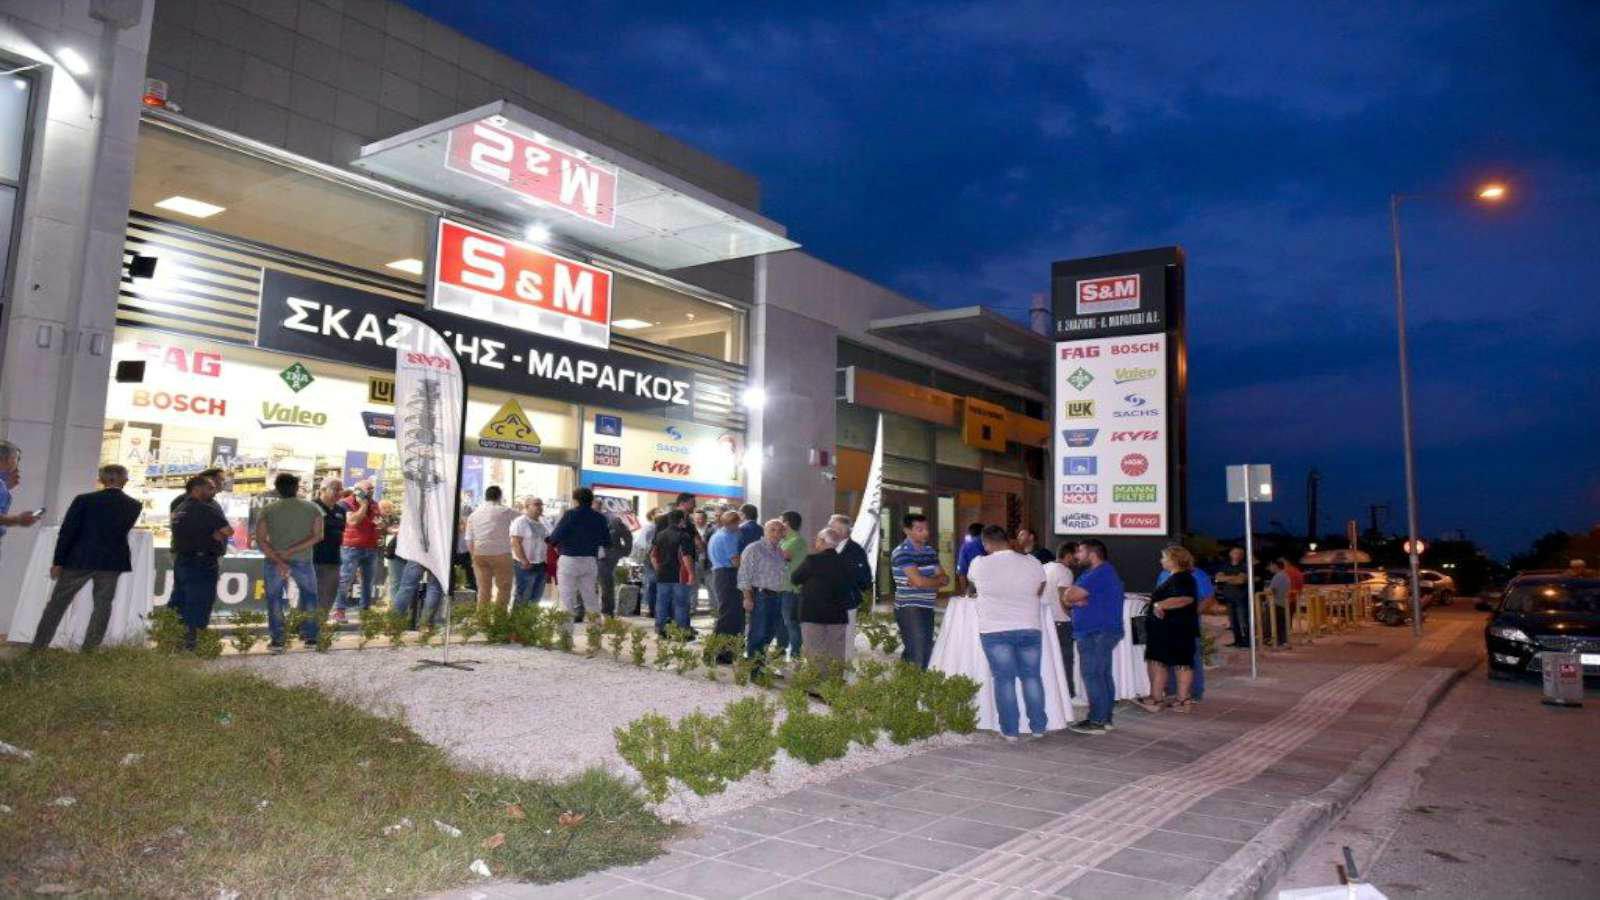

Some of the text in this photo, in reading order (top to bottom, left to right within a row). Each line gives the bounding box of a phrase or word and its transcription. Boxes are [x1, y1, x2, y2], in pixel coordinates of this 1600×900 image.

[461, 236, 594, 317] S&M
[1082, 279, 1136, 301] S&M
[1061, 346, 1100, 360] FAG
[1111, 342, 1160, 355] BOSCH
[528, 349, 690, 405] ΜΑΡΑΓΚΟΣ
[133, 390, 226, 417] BOSCH
[262, 401, 328, 426] Valeo
[1113, 408, 1160, 418] SACHS
[1114, 485, 1156, 493] MANN
[1063, 494, 1097, 503] MOLY
[1114, 493, 1156, 501] FILTER
